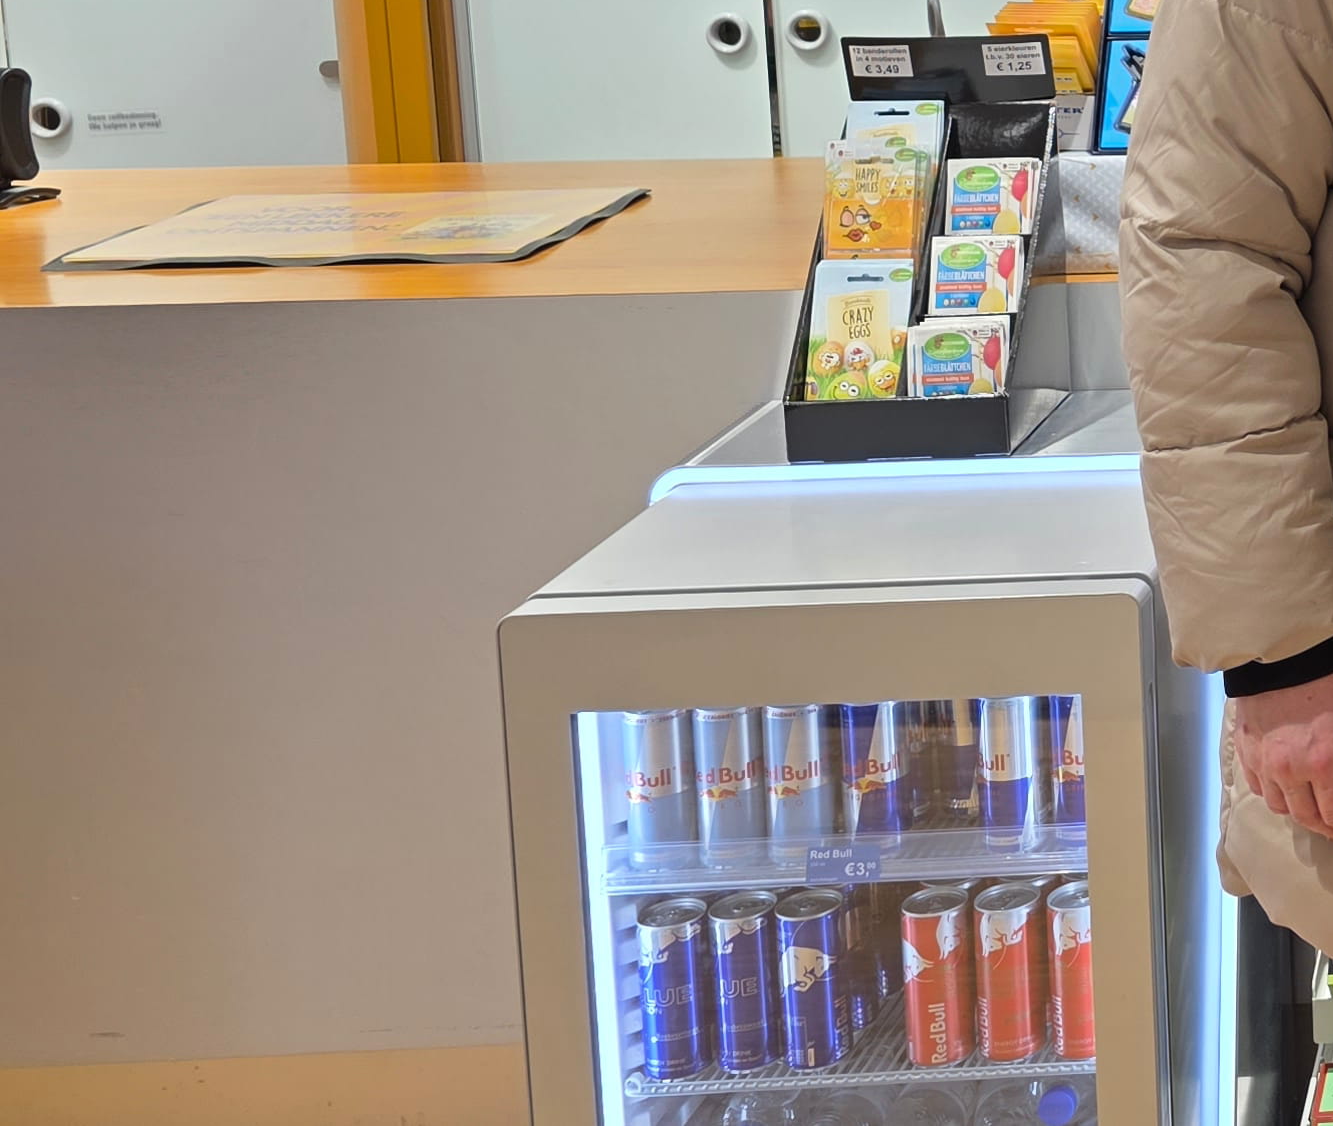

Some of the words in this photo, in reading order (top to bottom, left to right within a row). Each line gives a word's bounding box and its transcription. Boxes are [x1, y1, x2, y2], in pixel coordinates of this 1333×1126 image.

[865, 64, 872, 74] €
[875, 64, 900, 75] 3,49
[996, 62, 1004, 71] €
[1007, 61, 1032, 72] 1,25
[855, 168, 882, 181] HAPPY
[855, 180, 880, 194] SMILES
[842, 306, 874, 326] CRAZY
[848, 323, 871, 340] EGGS
[632, 768, 672, 788] Bull
[781, 760, 820, 782] Bull
[810, 849, 830, 859] Red
[832, 848, 853, 858] Bull
[928, 1002, 946, 1032] Bull
[930, 1033, 947, 1064] Red
